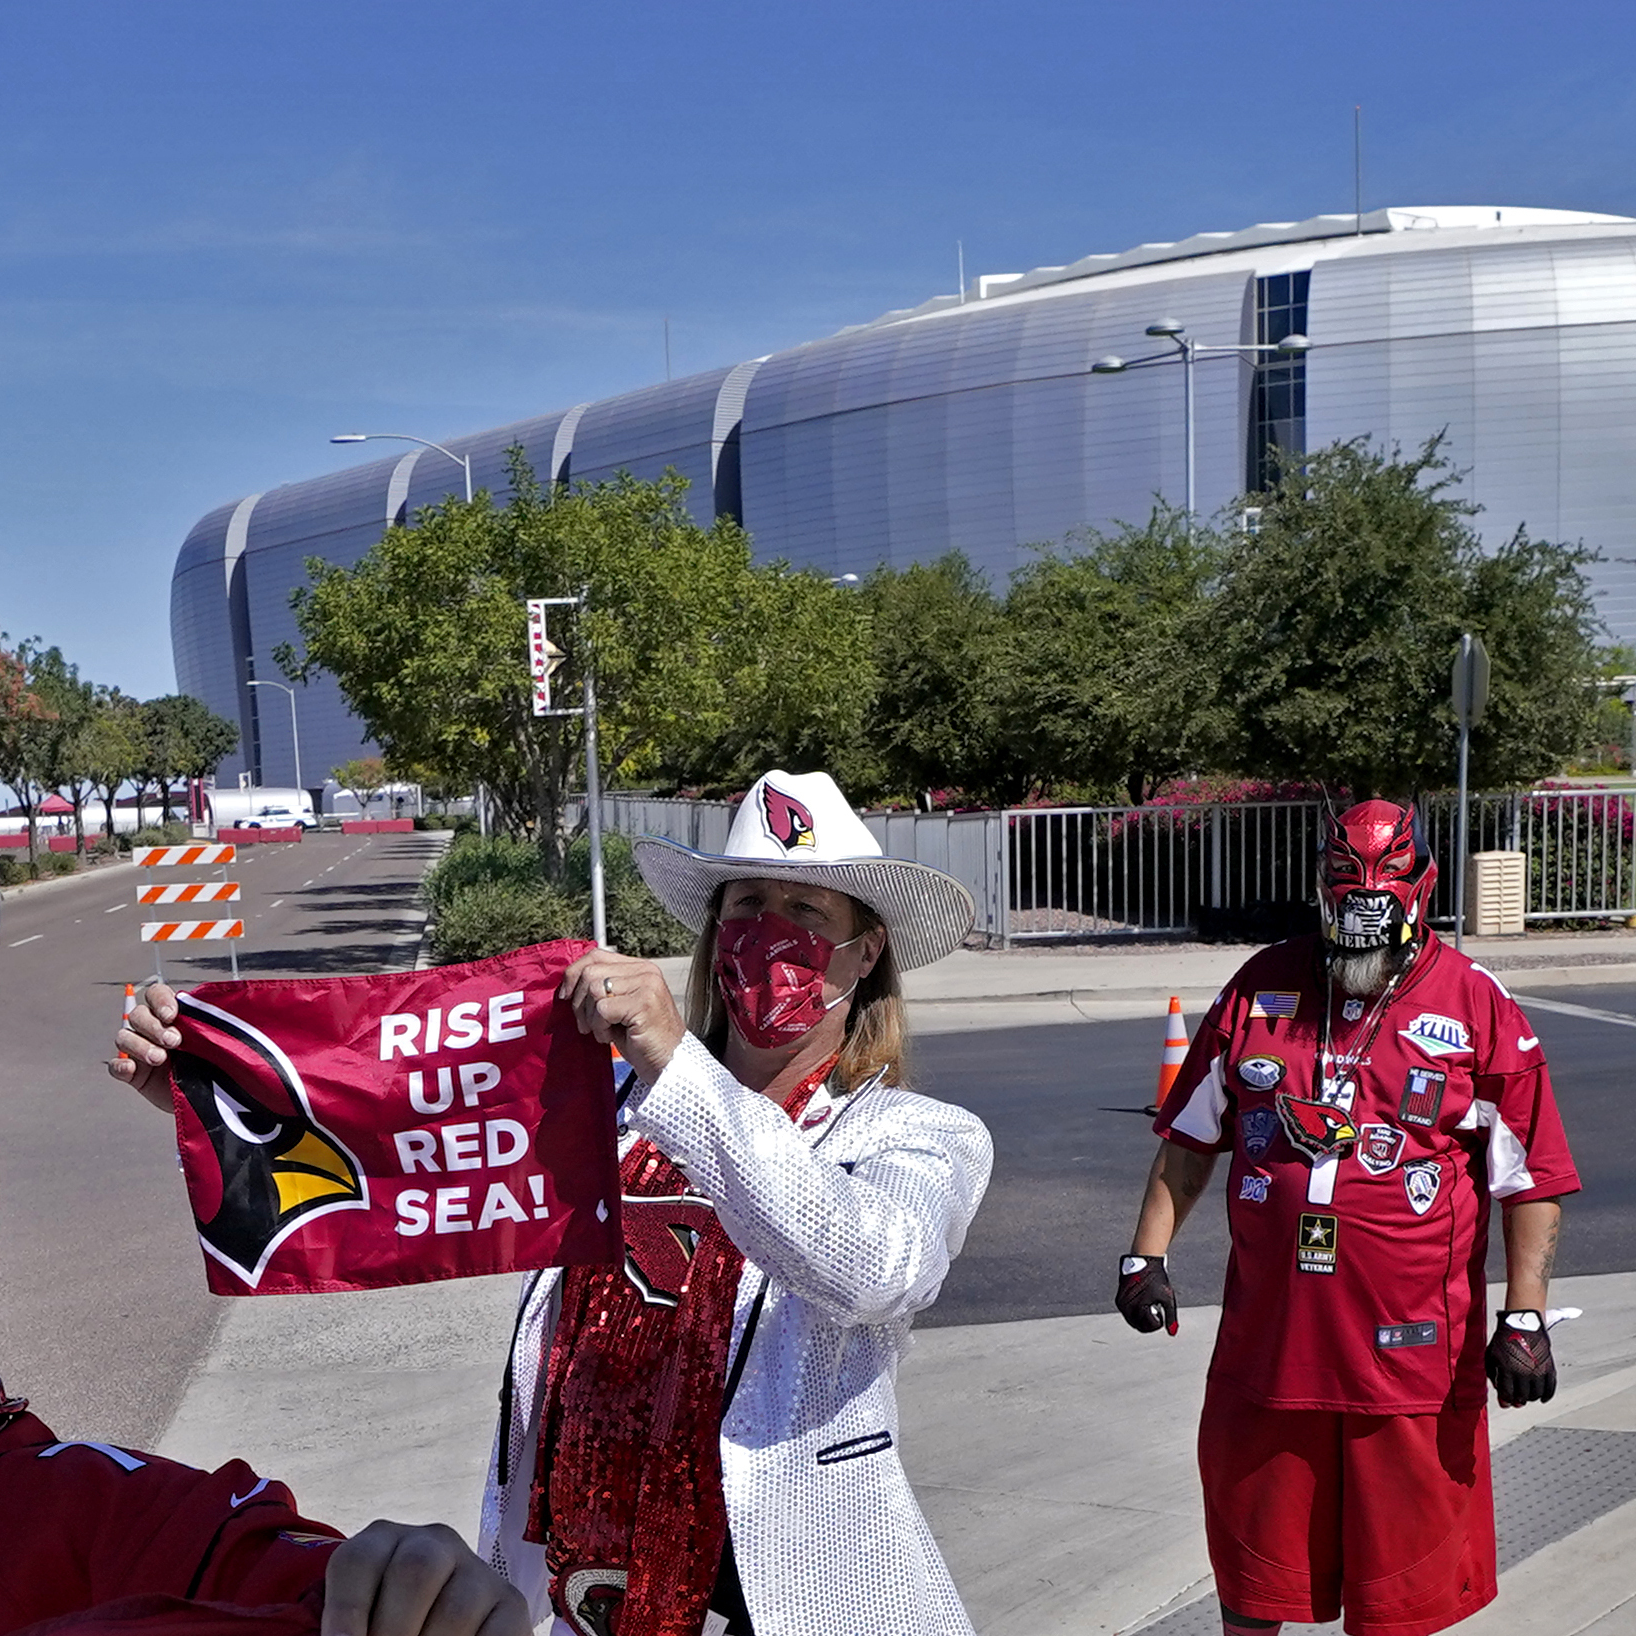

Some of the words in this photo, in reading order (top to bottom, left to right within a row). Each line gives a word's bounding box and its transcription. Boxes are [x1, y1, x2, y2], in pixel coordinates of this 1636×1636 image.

[1337, 933, 1390, 948] TERAN
[379, 991, 527, 1061] RISE
[1412, 1020, 1467, 1050] XLIII
[408, 1061, 502, 1115] UP
[393, 1118, 530, 1174] RED
[394, 1174, 550, 1237] SEA!
[1300, 1262, 1334, 1274] VETERAN
